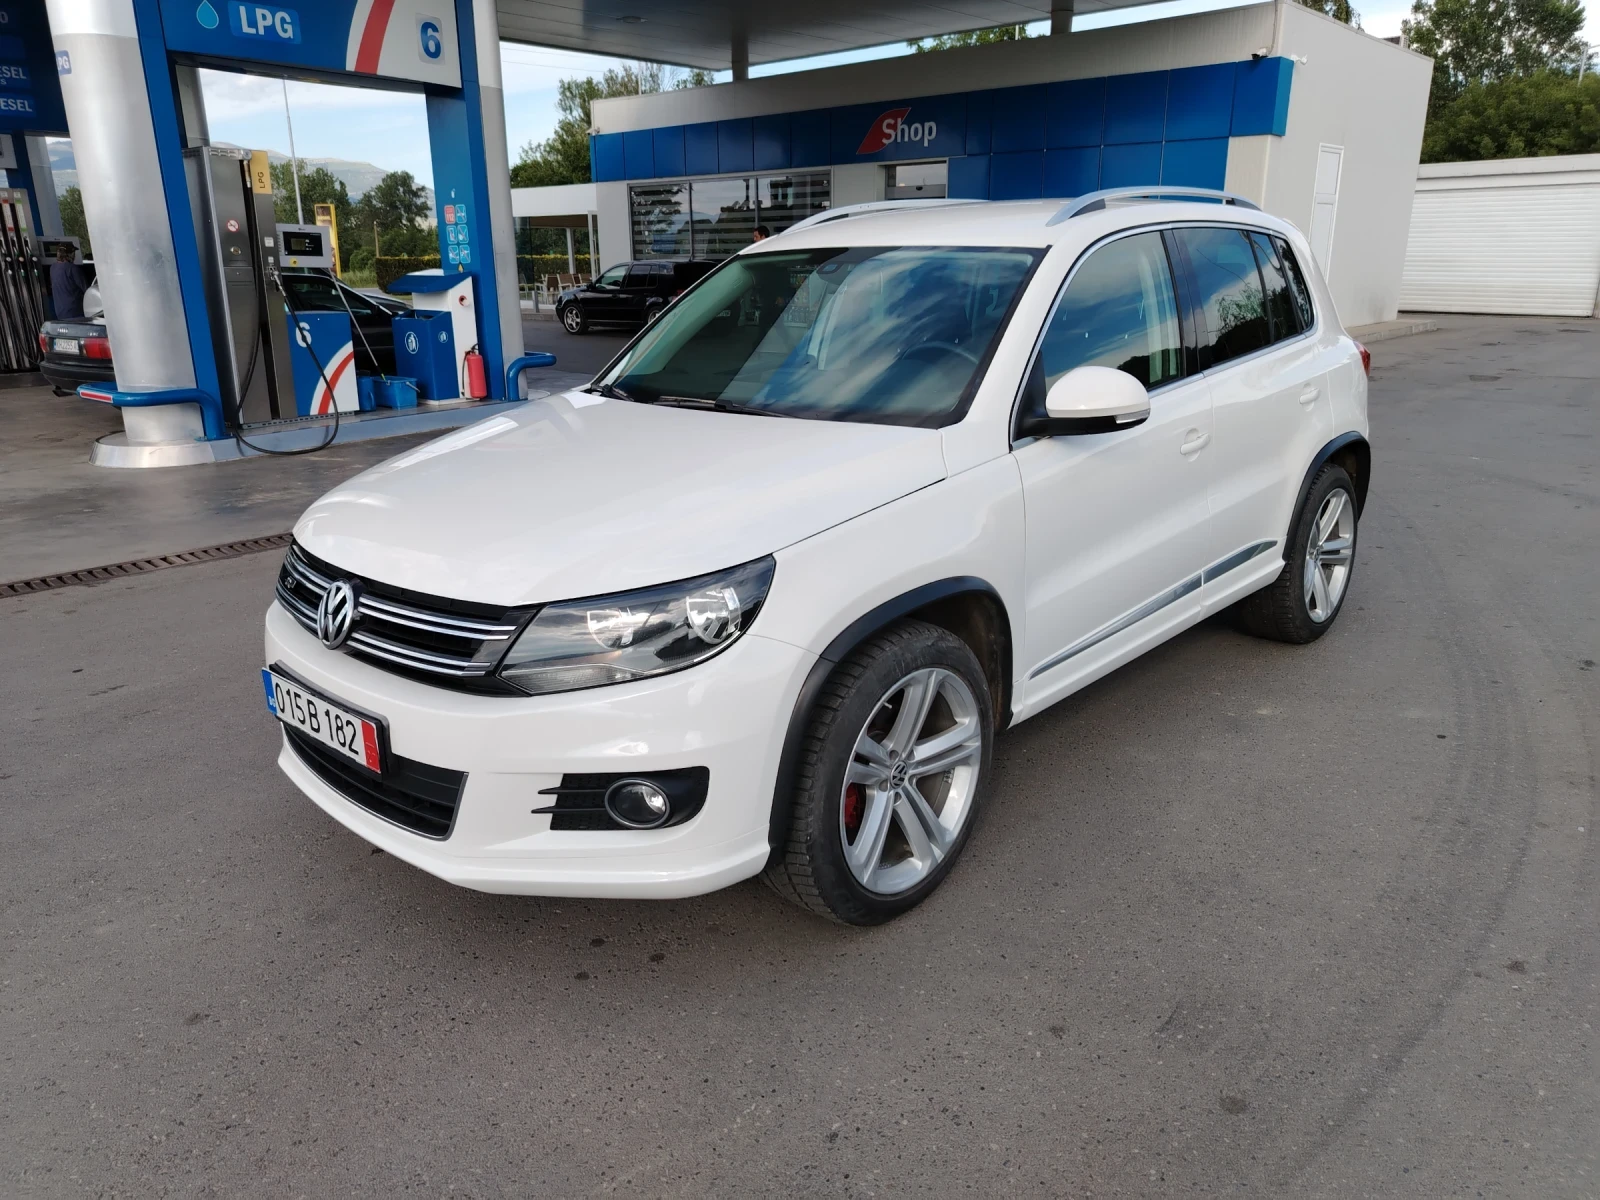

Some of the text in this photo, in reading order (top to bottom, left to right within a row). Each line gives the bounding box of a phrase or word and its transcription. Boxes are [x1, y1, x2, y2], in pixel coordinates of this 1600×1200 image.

[239, 5, 294, 39] LPG
[420, 21, 442, 59] 6
[881, 117, 937, 148] Shop
[257, 171, 265, 189] LPG
[296, 321, 311, 348] 6
